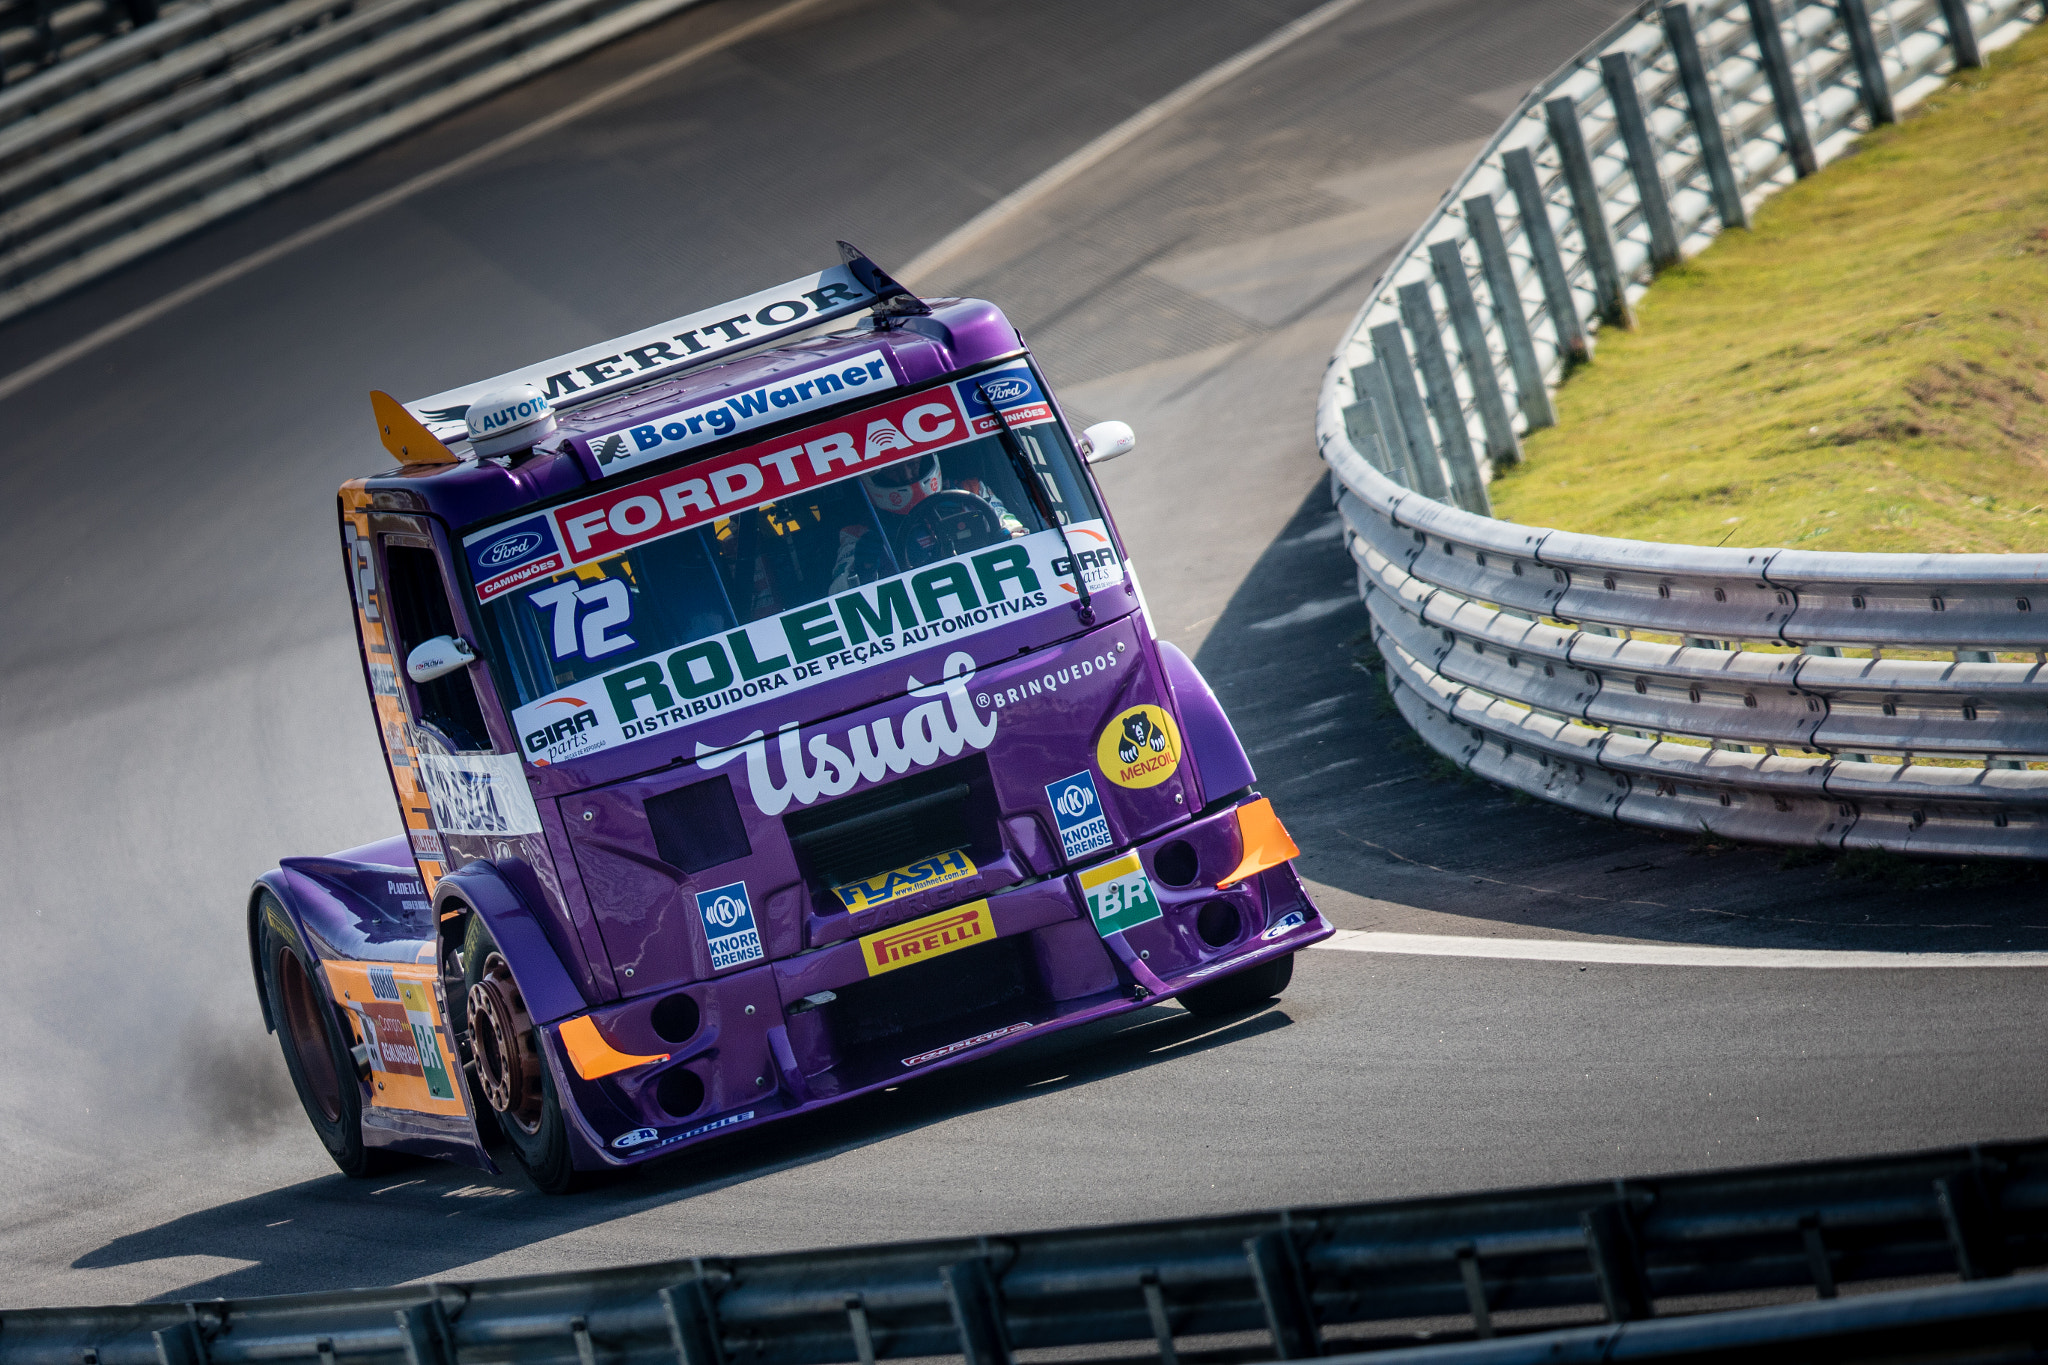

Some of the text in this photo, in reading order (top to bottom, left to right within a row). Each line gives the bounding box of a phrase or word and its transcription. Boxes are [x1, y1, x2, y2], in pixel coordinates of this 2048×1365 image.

[541, 282, 863, 400] MERITOR
[629, 357, 886, 452] BorgWarner
[987, 381, 1021, 401] Ford
[565, 402, 956, 554] FORDTRAC
[491, 538, 530, 562] Ford
[484, 559, 556, 593] CAMINHÕES
[1082, 567, 1110, 584] arts
[526, 577, 638, 662] 72
[602, 543, 1042, 724] ROLEMAR
[621, 592, 1048, 740] DISTRIBUIDORA DE PEÇAS AUTOMOTIVAS
[994, 651, 1117, 708] BRINQUEDOS
[525, 708, 599, 753] GIRA
[547, 733, 588, 764] parts
[695, 651, 998, 816] Usual
[1120, 751, 1176, 783] MENZOIL
[1062, 819, 1108, 846] KNORR
[1066, 832, 1112, 857] BREMSE
[838, 850, 967, 905] FLASH
[894, 868, 969, 897] www.flashnet.com.br
[1097, 878, 1149, 920] BR
[709, 931, 759, 955] KNORR
[713, 945, 762, 967] BREMSE
[872, 910, 982, 966] PIRELLI
